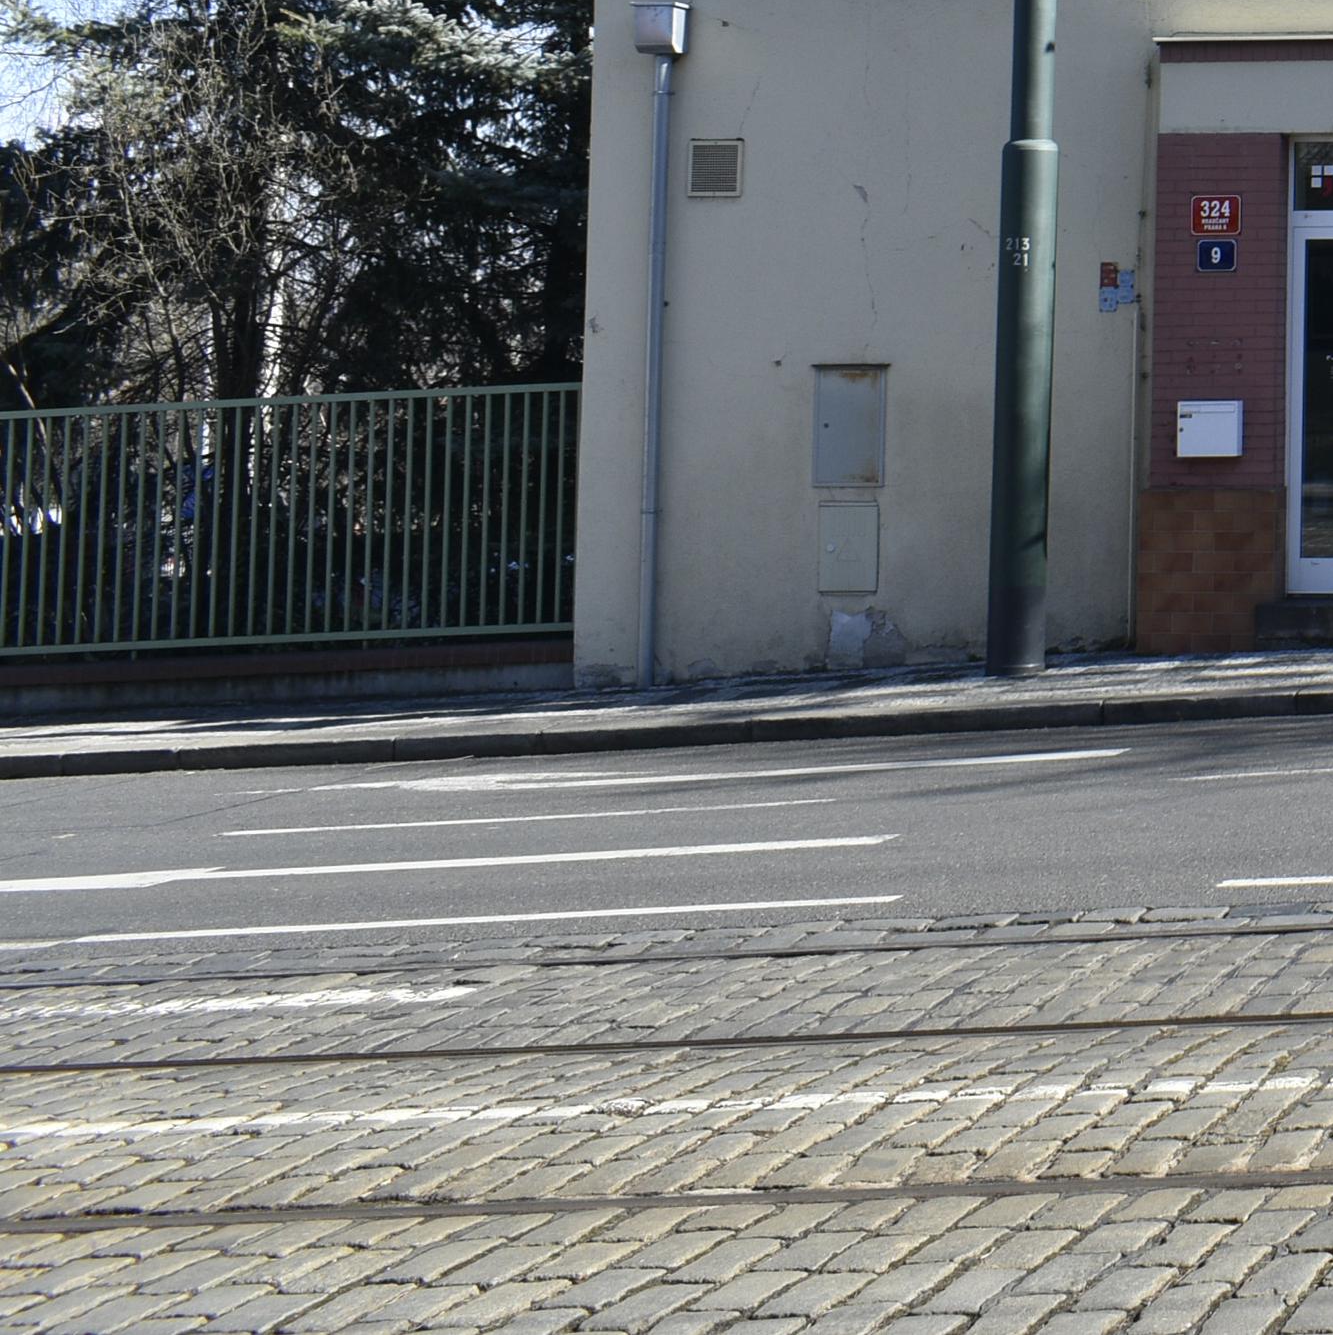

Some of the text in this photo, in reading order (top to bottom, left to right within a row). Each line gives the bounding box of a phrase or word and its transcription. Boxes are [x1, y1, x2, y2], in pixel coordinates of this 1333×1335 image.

[1200, 200, 1231, 217] 324
[1006, 237, 1030, 251] 213
[1014, 253, 1028, 266] 21
[1211, 247, 1221, 263] 9
